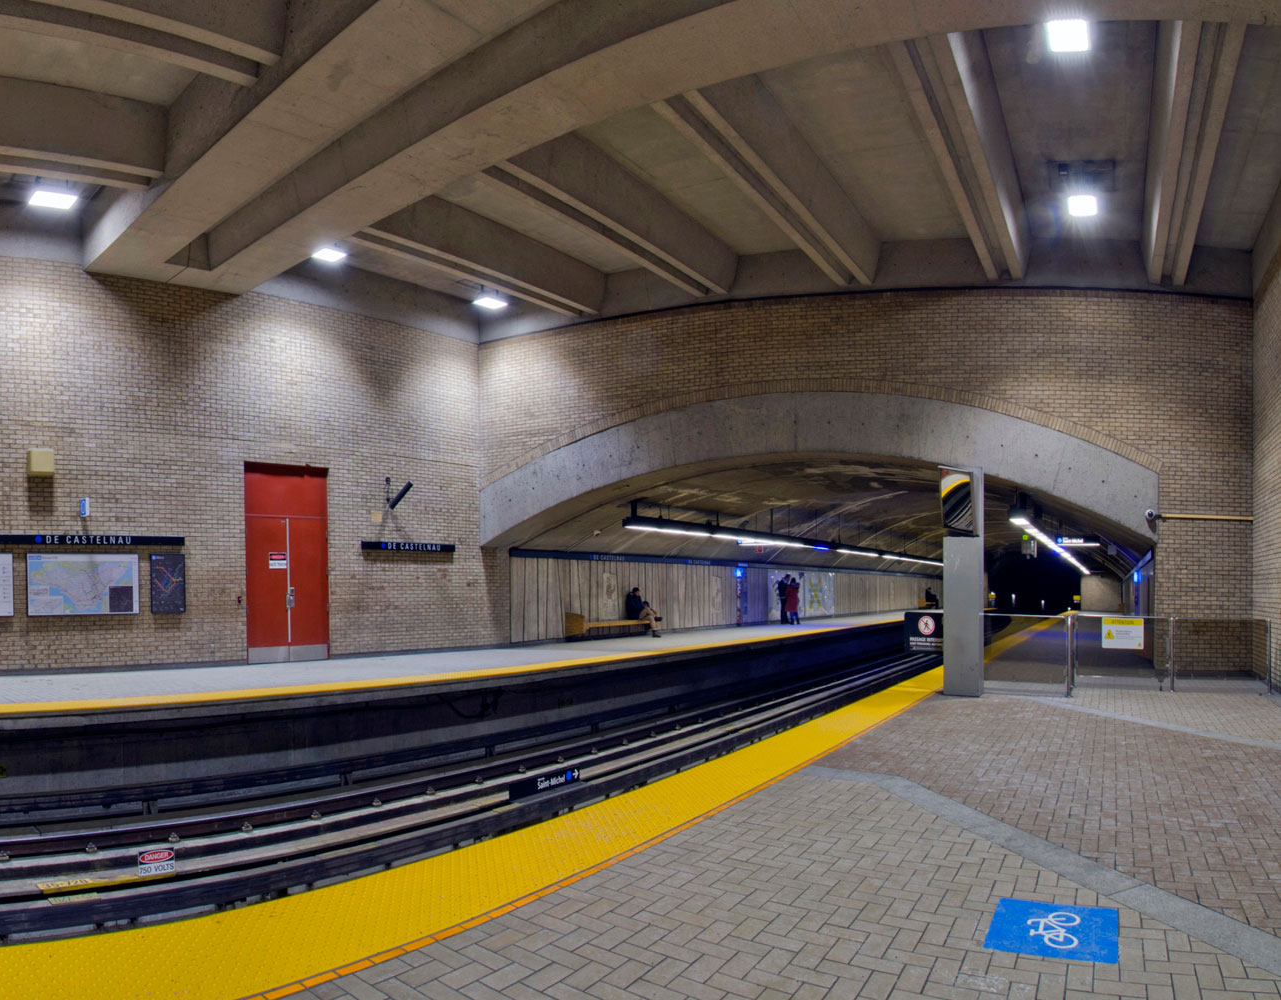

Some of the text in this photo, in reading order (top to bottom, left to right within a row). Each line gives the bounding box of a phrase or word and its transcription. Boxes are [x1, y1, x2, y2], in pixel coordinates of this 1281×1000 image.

[46, 534, 132, 545] DE CASTELNAU
[387, 542, 441, 551] DE CASTELNAU
[144, 851, 169, 861] DANGER
[139, 862, 175, 875] 750 VOLTS
